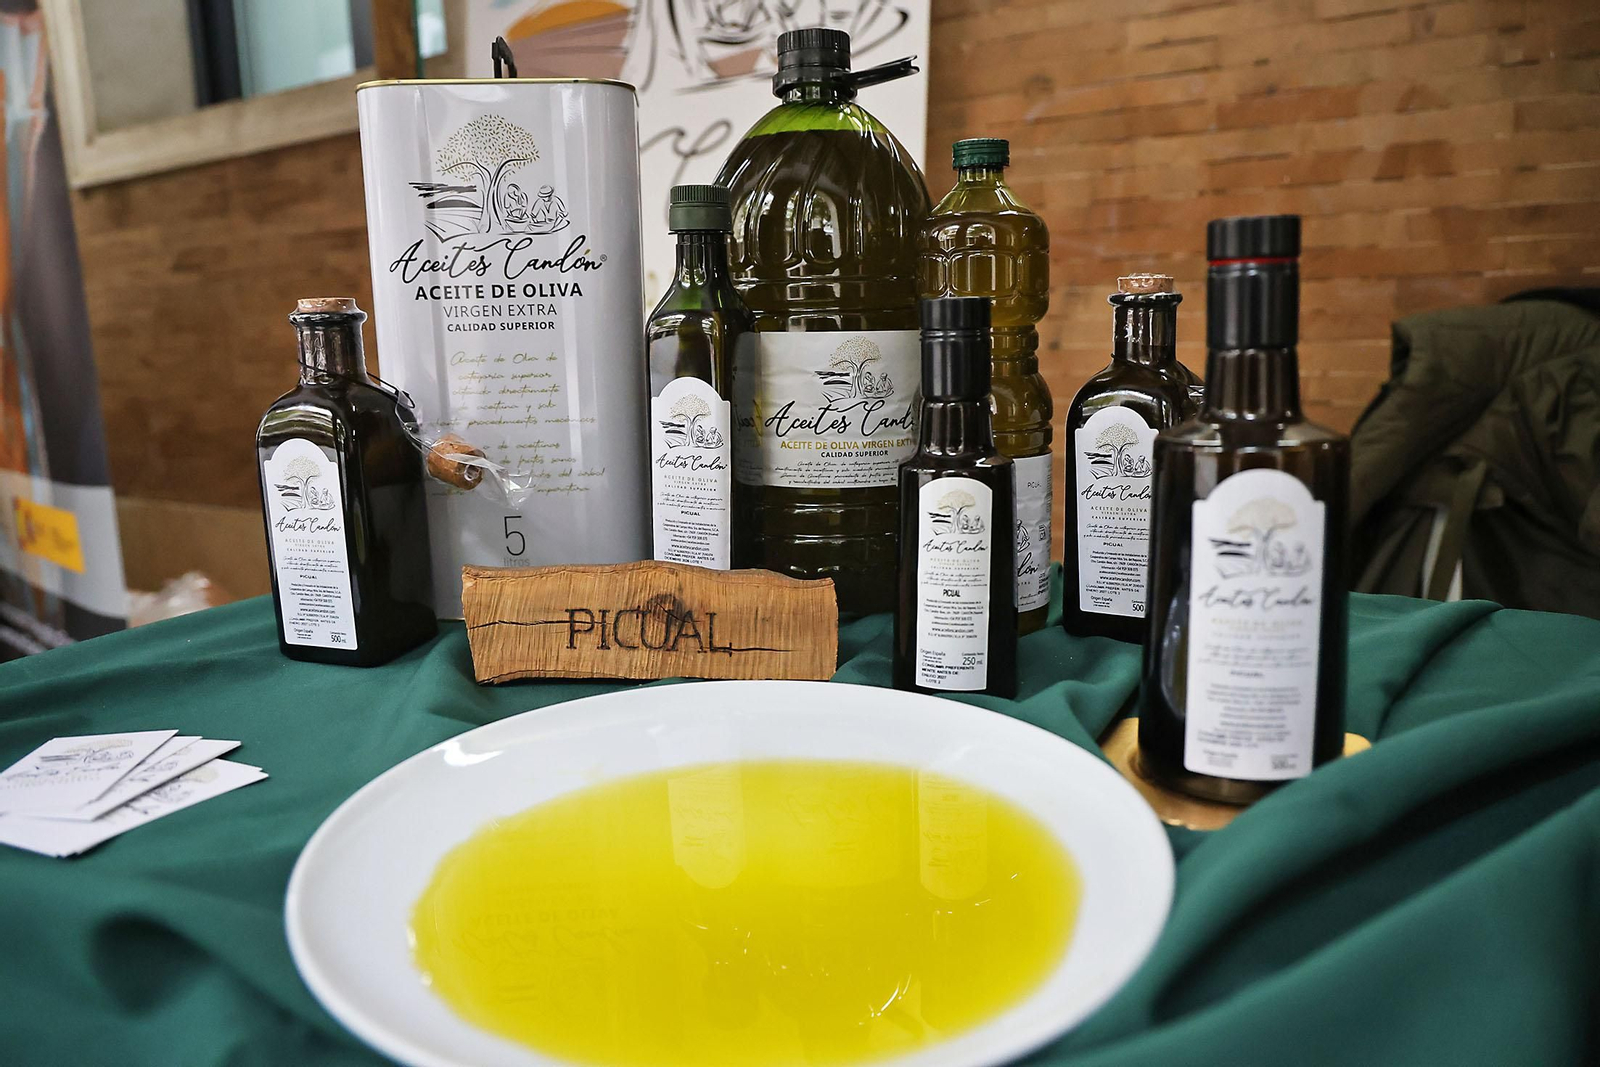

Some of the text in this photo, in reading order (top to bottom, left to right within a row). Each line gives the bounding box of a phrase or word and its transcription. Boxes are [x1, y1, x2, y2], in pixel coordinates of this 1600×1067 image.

[389, 239, 496, 284] Aceites
[415, 282, 583, 300] ACEITE DE OLIVA
[443, 303, 557, 318] VIRGEN EXTRA
[447, 321, 555, 332] CALIDAD SUPERIOR
[546, 352, 557, 361] de
[765, 401, 851, 437] Aceites
[780, 441, 812, 449] ACEITE
[815, 441, 828, 449] DE
[831, 440, 859, 449] OLIVA
[861, 439, 894, 449] VIRGEN
[821, 450, 853, 458] CALIDAD
[504, 515, 526, 556] 5
[503, 557, 530, 567] litros
[1132, 603, 1145, 612] 500
[565, 605, 732, 657] PICUAL
[331, 634, 341, 643] 500
[962, 656, 976, 666] 250
